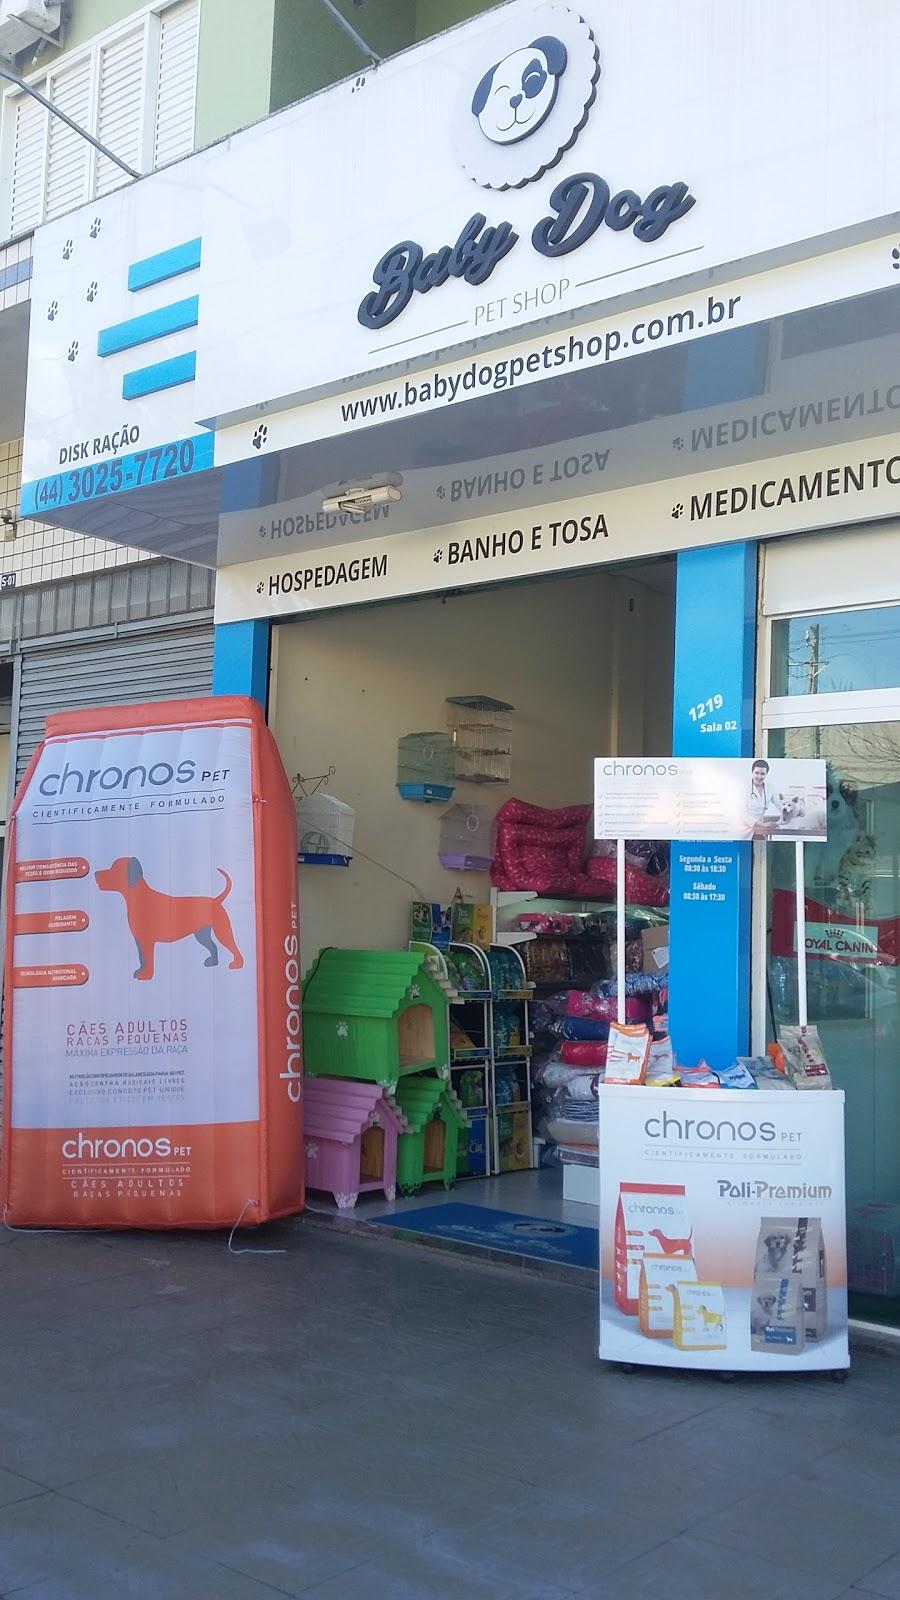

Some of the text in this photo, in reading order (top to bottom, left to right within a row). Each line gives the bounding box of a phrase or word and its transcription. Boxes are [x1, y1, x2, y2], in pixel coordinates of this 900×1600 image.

[357, 172, 696, 329] Baby Dog
[474, 279, 570, 327] PET SHOP
[340, 293, 741, 421] www.babydogpetshop.com.br
[59, 424, 140, 464] DISK RAÇÃO
[35, 440, 194, 510] (44) 3025-7720
[448, 514, 609, 565] BANHO E TOSA
[268, 555, 388, 596] HOSPEDAGEM
[689, 694, 723, 721] 1219
[700, 720, 737, 733] Sala 02
[603, 760, 678, 776] chronos
[39, 760, 230, 796] chronos PET
[33, 795, 225, 818] CIENTIFICAMENTE FORMULADO
[679, 855, 706, 864] Segunda
[714, 855, 733, 863] Sexta
[692, 882, 717, 890] Sábado
[709, 893, 726, 901] 17:30
[804, 938, 873, 953] OYAL CANIN
[280, 902, 301, 1103] chronos PET
[67, 1018, 188, 1036] CÃES ADULTOS
[117, 1032, 188, 1045] PEQUENAS
[152, 1046, 164, 1055] DA
[644, 1111, 802, 1141] chronos PET
[62, 1132, 191, 1158] chronos PET
[645, 1149, 802, 1160] CIENTIFICAMENTE FORMULADO
[62, 1167, 135, 1175] CIENTIFICAMENTE
[118, 1178, 184, 1188] ADULTOS
[717, 1179, 832, 1199] Poli-Premium
[118, 1189, 181, 1198] PEQUENAS
[628, 1203, 675, 1216] chronos
